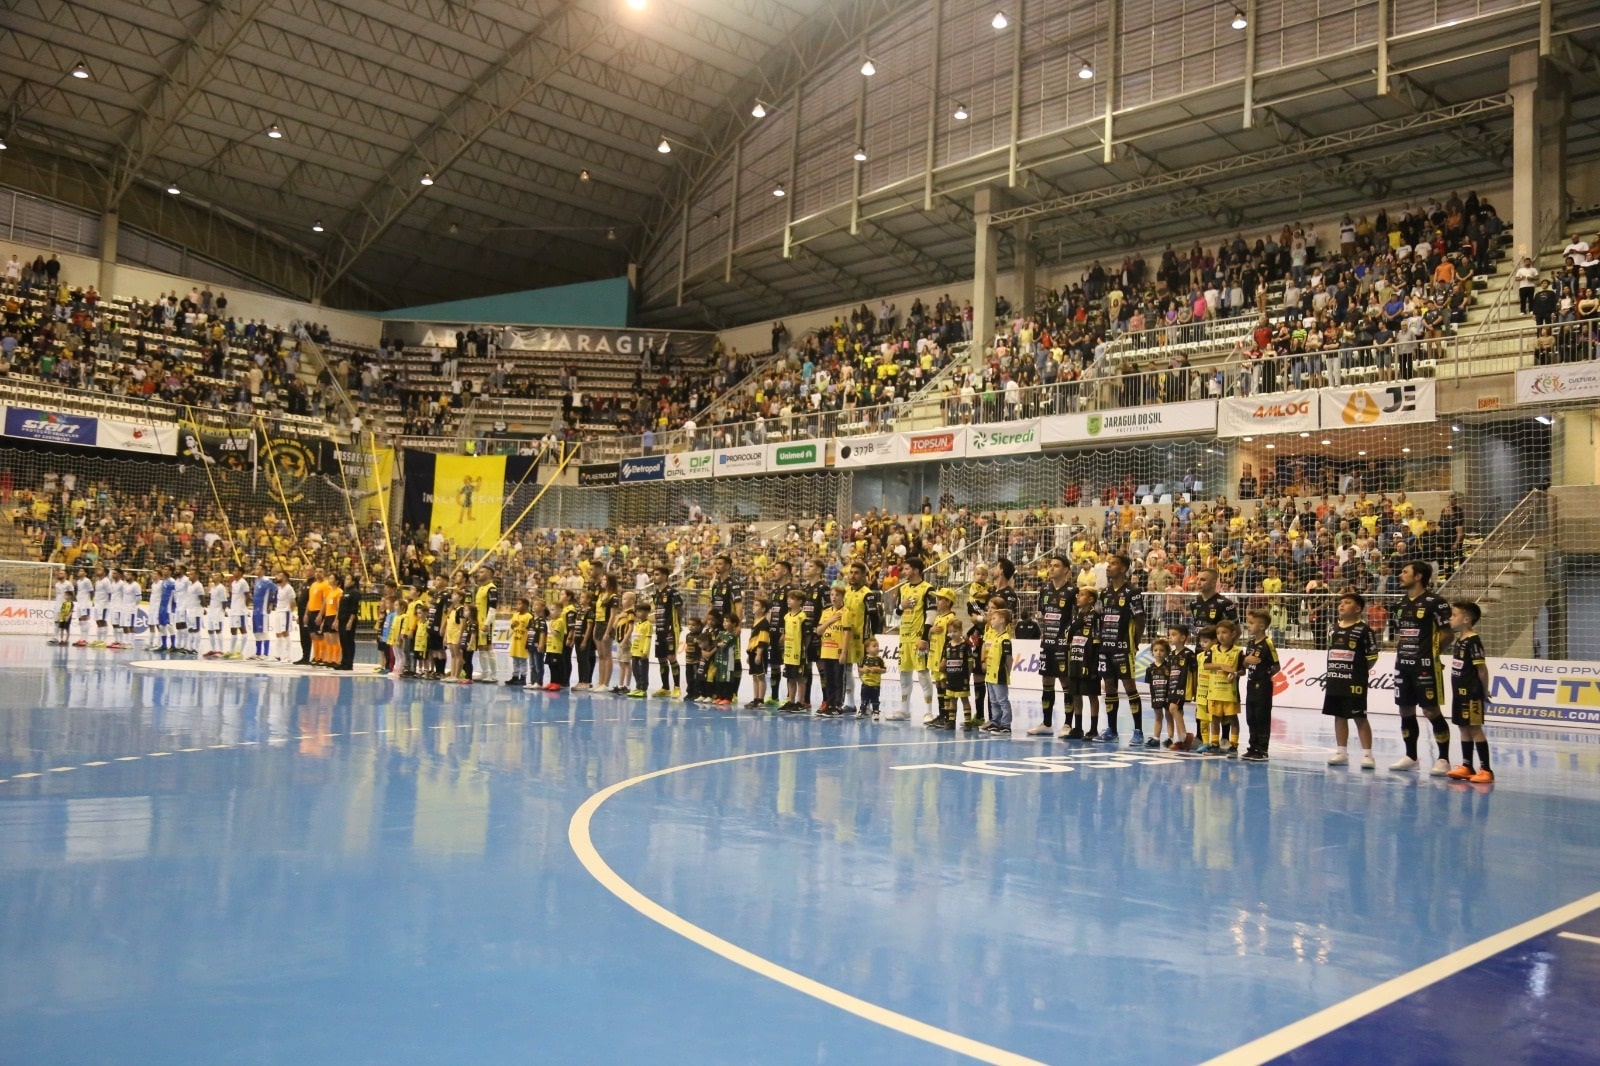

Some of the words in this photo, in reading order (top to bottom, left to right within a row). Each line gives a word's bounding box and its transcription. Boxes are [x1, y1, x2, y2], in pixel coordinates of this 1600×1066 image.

[1382, 385, 1416, 413] JE
[1252, 401, 1310, 419] AMLOG
[1104, 413, 1137, 428] JARAGUÁ
[1138, 414, 1148, 424] DO
[1148, 412, 1162, 424] SUL
[913, 437, 949, 450] TOPSUN
[991, 429, 1035, 446] Sicredi
[780, 449, 804, 461] Unimed
[1421, 658, 1431, 666] 10
[1500, 663, 1553, 674] ASSINE
[1349, 685, 1363, 695] 10
[1491, 675, 1600, 703] NFT
